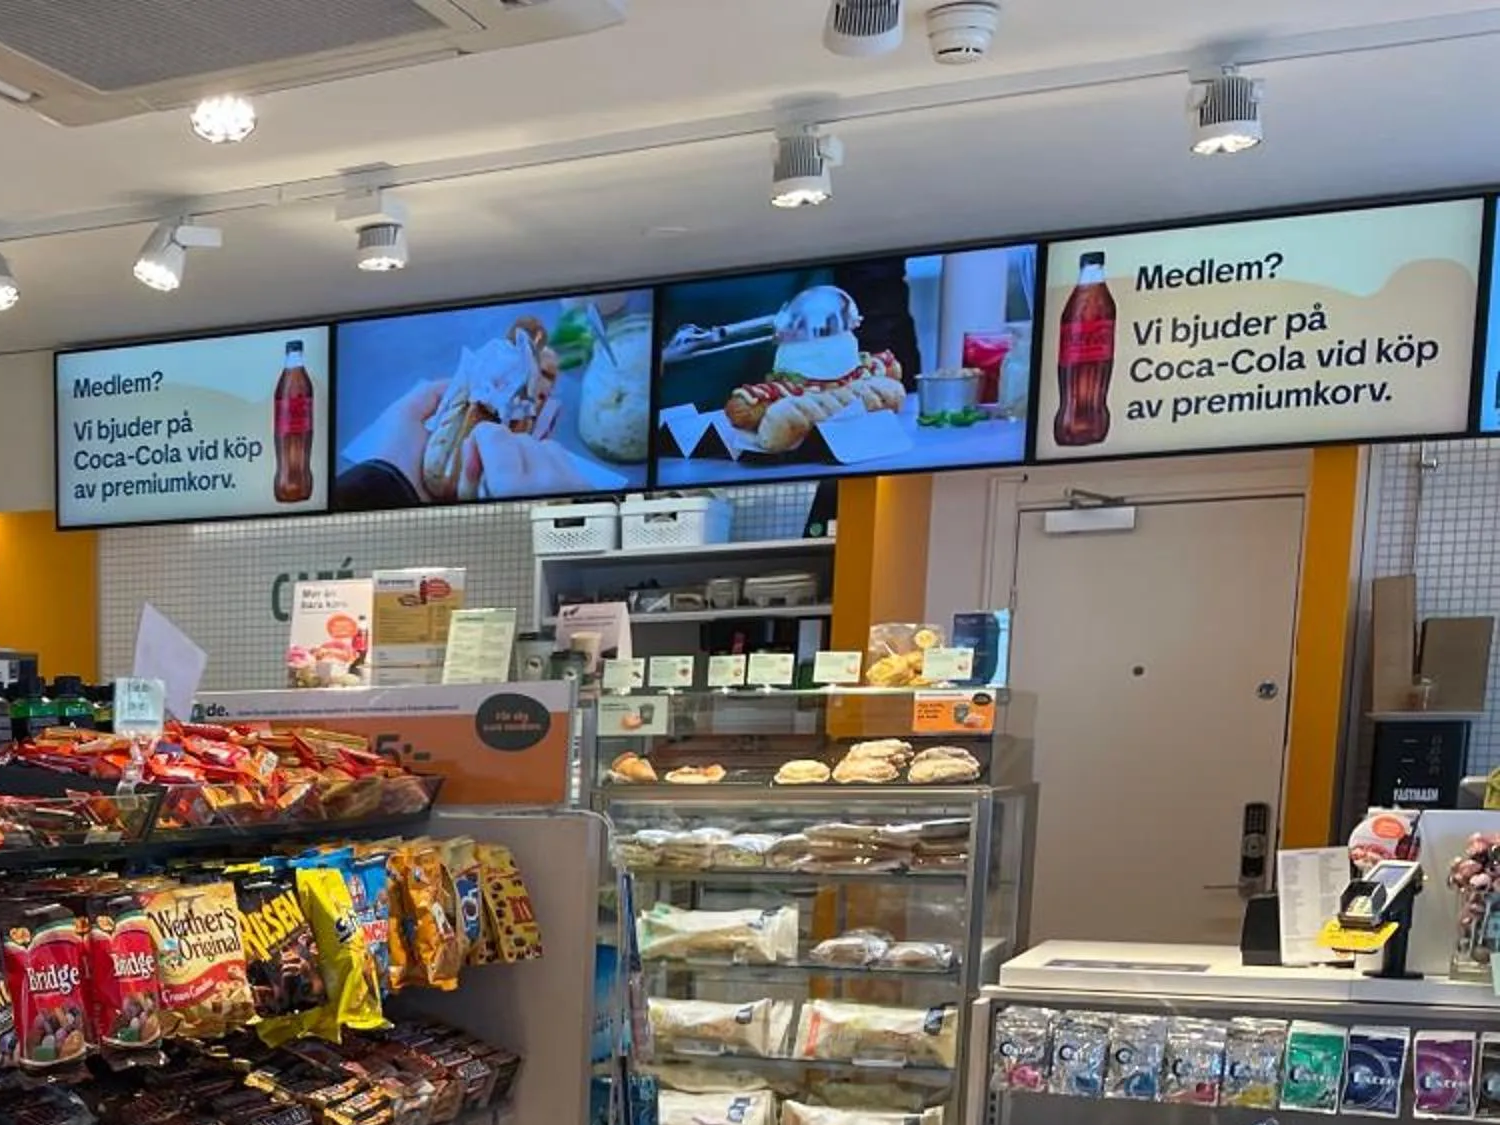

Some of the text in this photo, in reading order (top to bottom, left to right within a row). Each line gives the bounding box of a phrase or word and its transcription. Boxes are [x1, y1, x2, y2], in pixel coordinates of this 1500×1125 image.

[1135, 252, 1284, 292] Medlem?
[1133, 302, 1328, 348] Vi bjuder på
[1129, 334, 1439, 383] Coca-Cola vid köp
[73, 371, 163, 398] Medlem?
[1127, 380, 1392, 423] av premiumkorv.
[74, 409, 193, 444] Vi bjuder på
[74, 436, 263, 470] Coca-Cola vid köp
[74, 471, 236, 502] av premiumkorv.
[148, 905, 238, 939] Werther's
[239, 890, 306, 962] RIESEN
[178, 930, 242, 963] Original
[26, 963, 81, 995] Bridge
